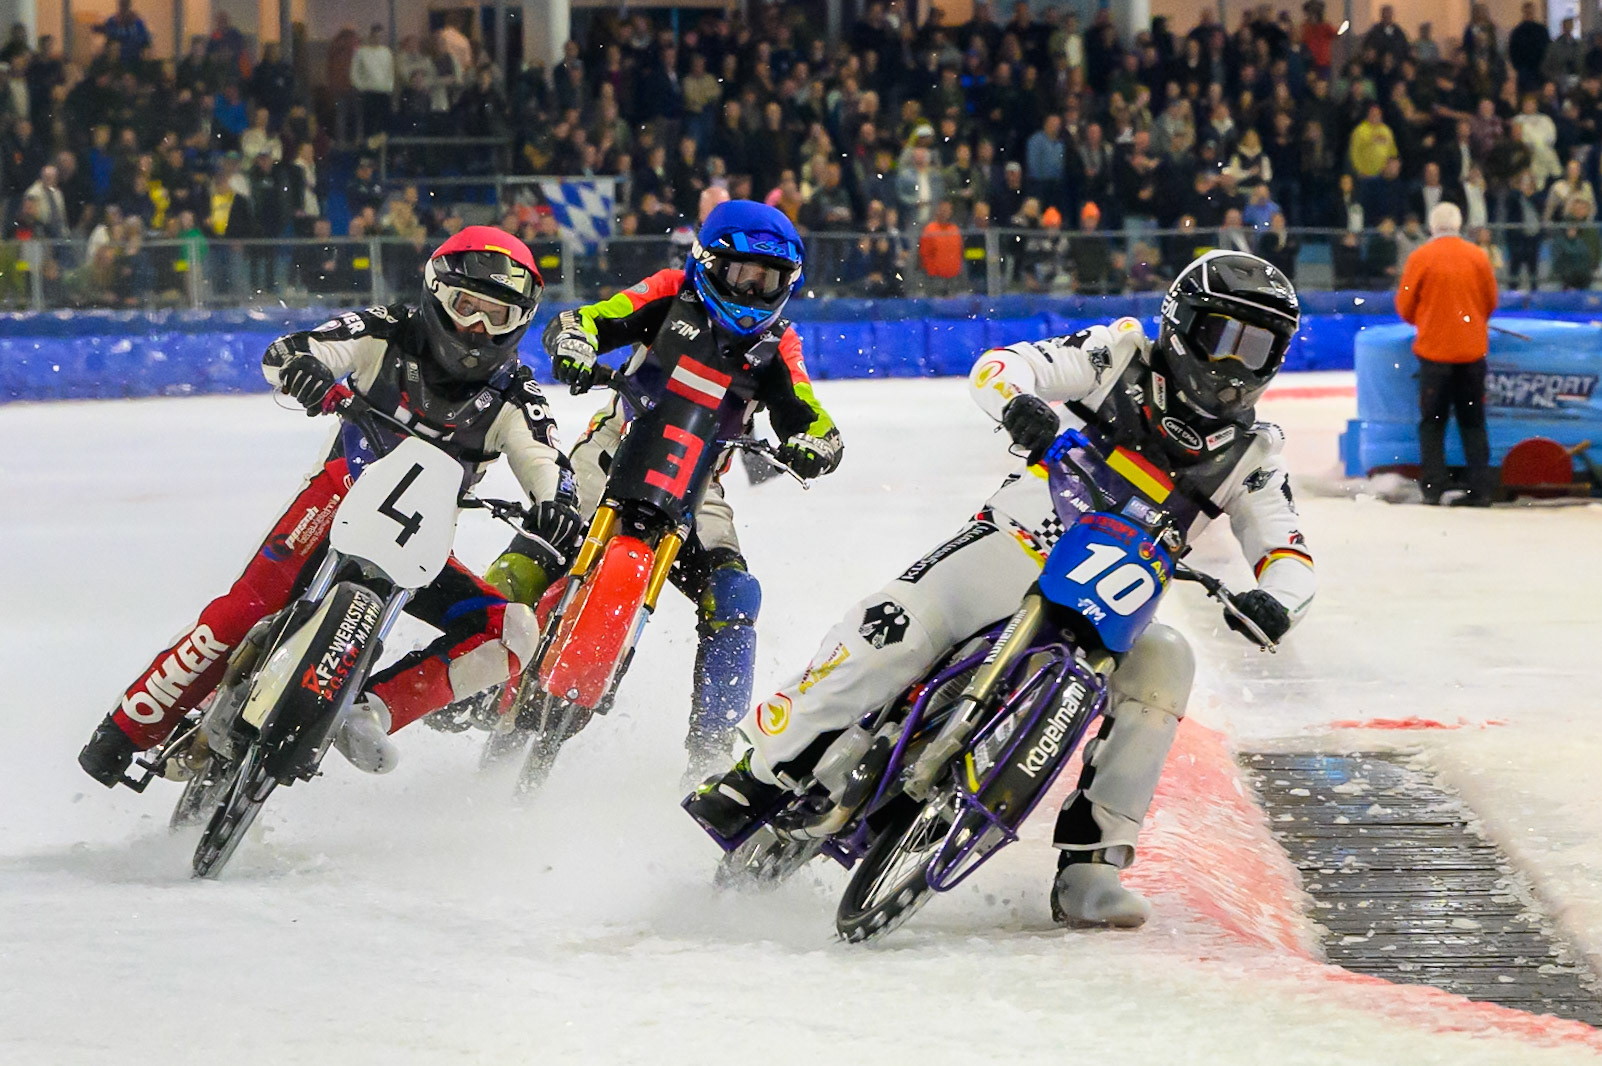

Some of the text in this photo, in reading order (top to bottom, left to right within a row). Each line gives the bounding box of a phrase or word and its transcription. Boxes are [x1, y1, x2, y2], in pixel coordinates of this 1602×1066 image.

[644, 423, 704, 500] 3
[377, 462, 425, 548] 4
[1065, 543, 1156, 617] 10
[1016, 680, 1087, 778] kugelmann
